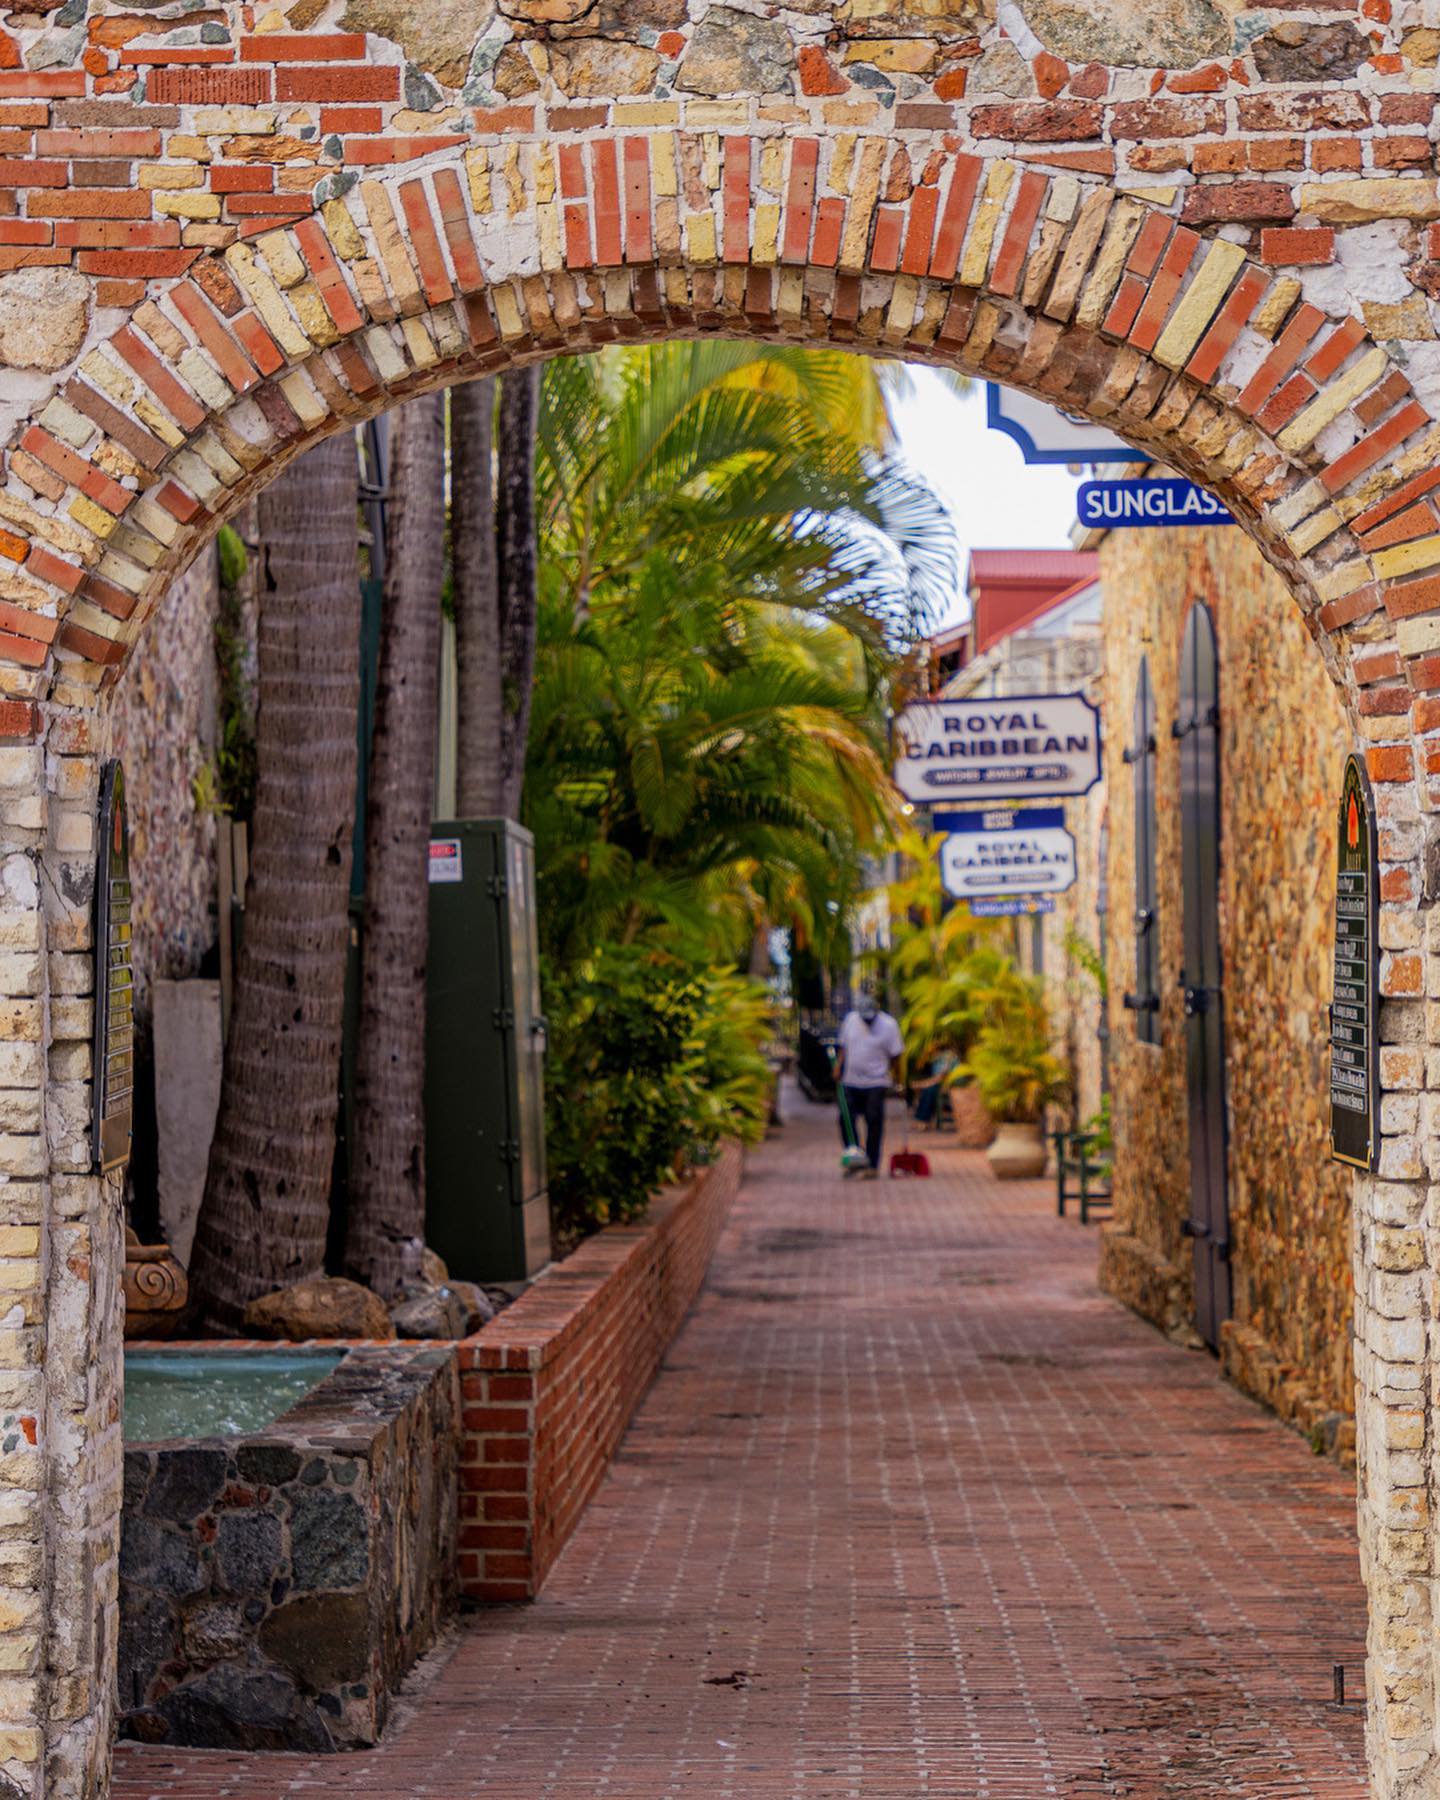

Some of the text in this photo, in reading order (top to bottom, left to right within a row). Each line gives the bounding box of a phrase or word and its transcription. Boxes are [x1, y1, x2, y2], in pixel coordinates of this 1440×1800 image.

[944, 713, 1047, 733] ROYAL
[906, 736, 1088, 760] CARIBBEAN
[977, 842, 1042, 854] ROYAL
[952, 854, 1069, 869] CARIBBEAN
